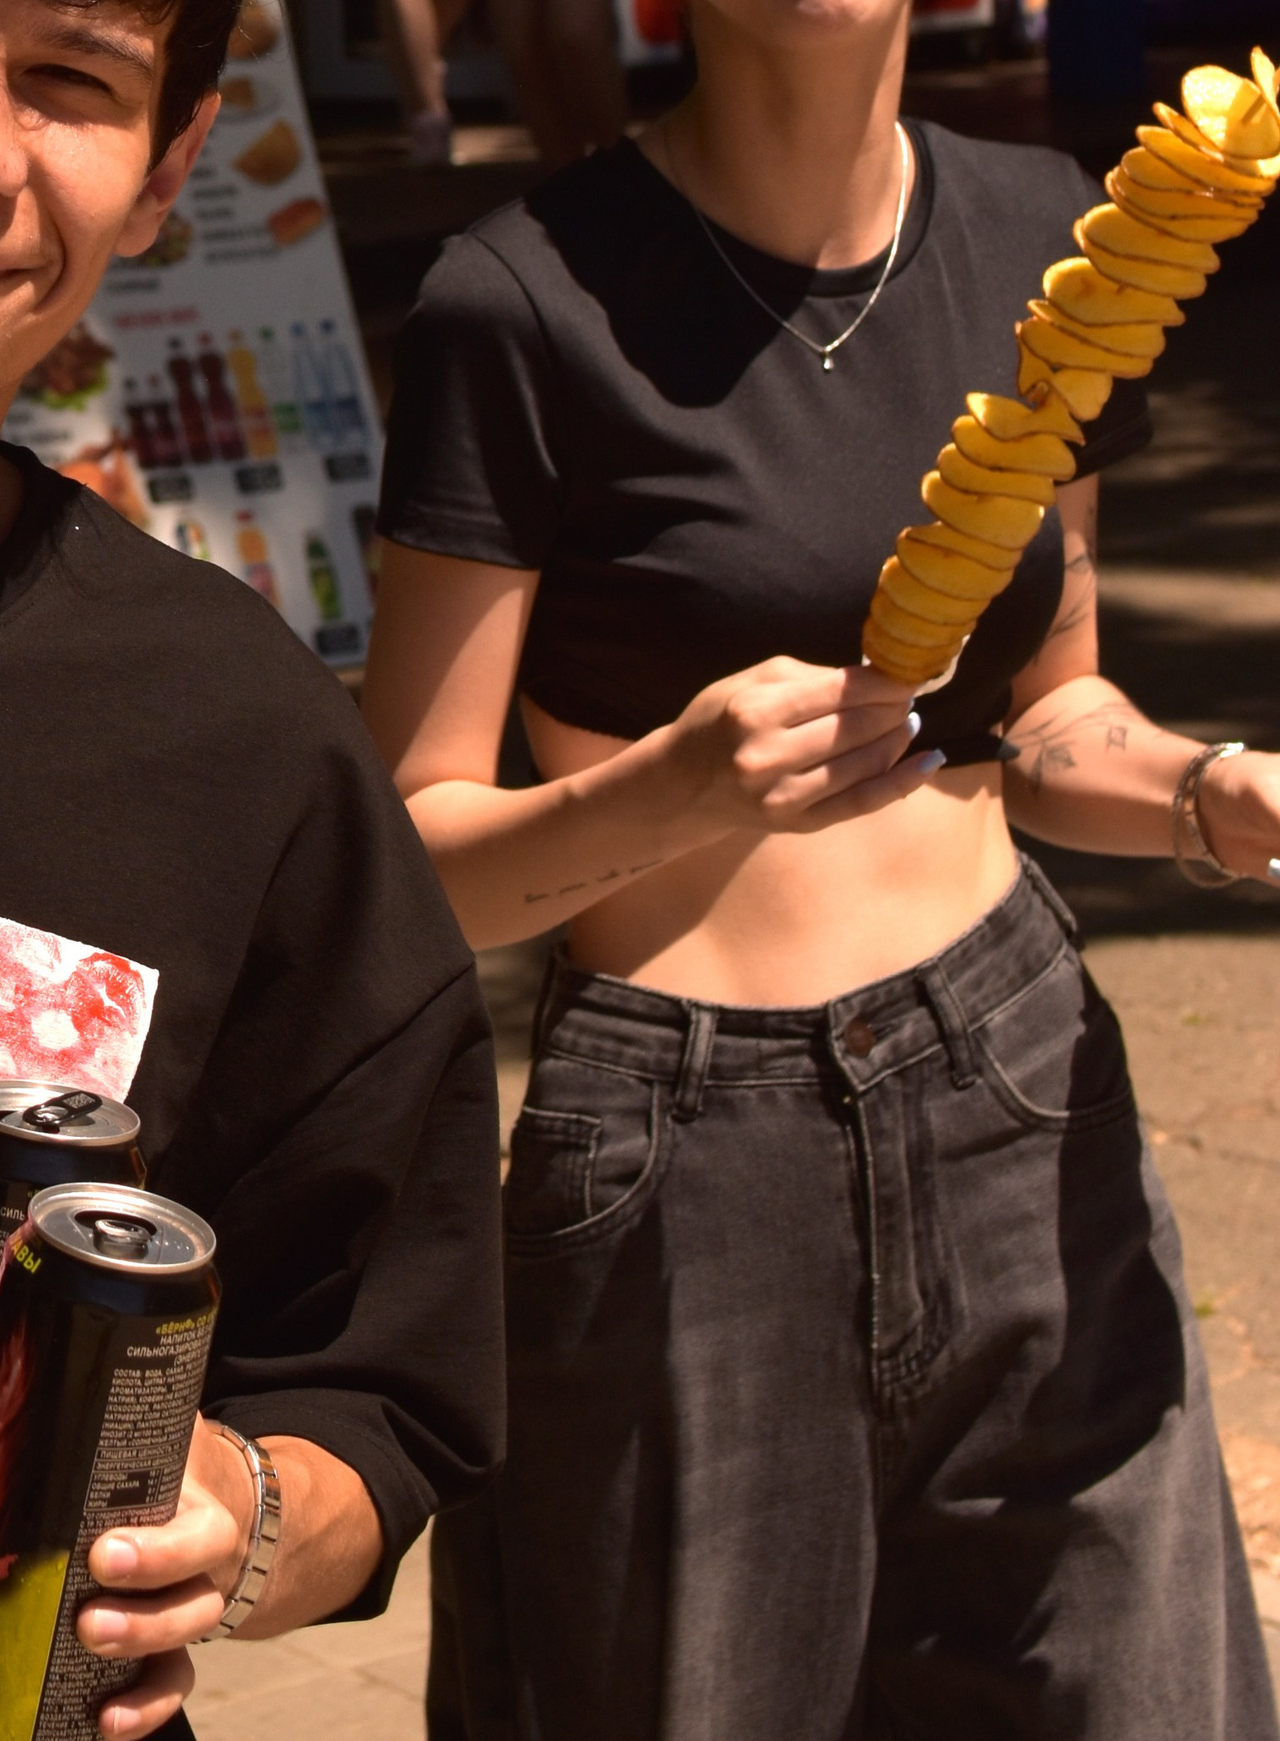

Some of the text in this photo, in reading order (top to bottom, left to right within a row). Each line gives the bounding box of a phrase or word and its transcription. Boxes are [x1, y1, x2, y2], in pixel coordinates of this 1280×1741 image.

[160, 1329, 197, 1346] НАПИТОК
[100, 1450, 137, 1459] ПИЩЕВАЯ
[138, 1444, 172, 1458] ЦЕННОСТЬ
[96, 1459, 152, 1470] ЭНЕРГЕТИЧЕСКАЯ
[87, 1500, 108, 1508] ЖИРЫ
